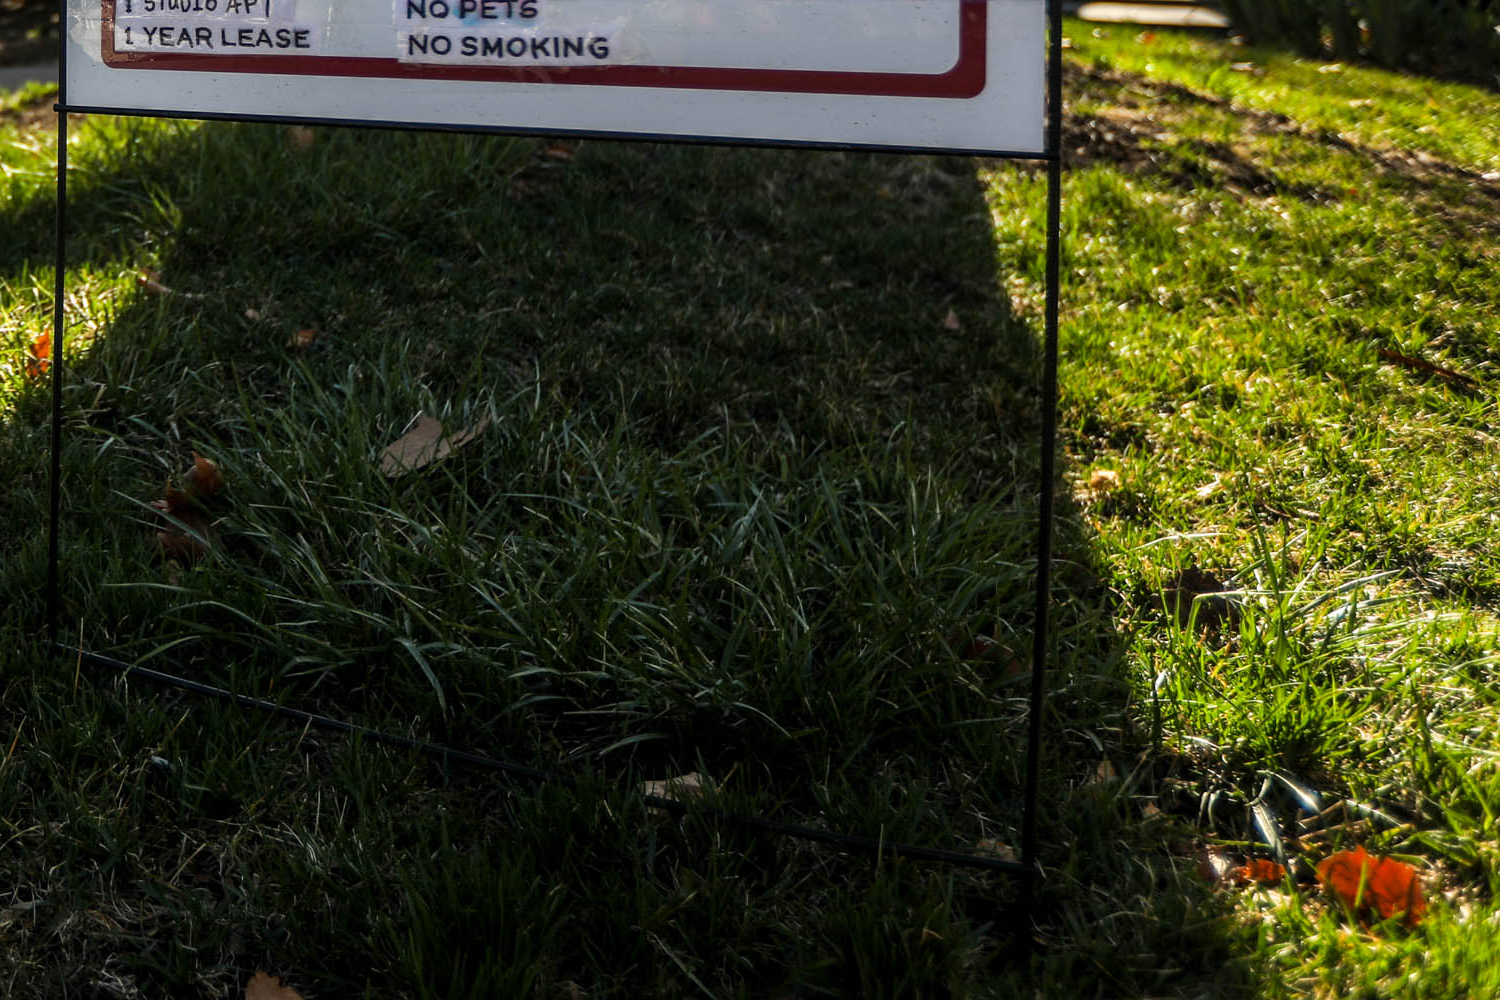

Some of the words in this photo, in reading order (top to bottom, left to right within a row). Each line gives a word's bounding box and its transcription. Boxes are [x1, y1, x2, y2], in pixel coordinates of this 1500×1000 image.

[406, 0, 450, 20] NO
[124, 27, 135, 46] 1
[143, 27, 214, 49] YEAR
[220, 27, 311, 49] LEASE
[408, 34, 452, 56] NO
[460, 36, 610, 60] SMOKING
